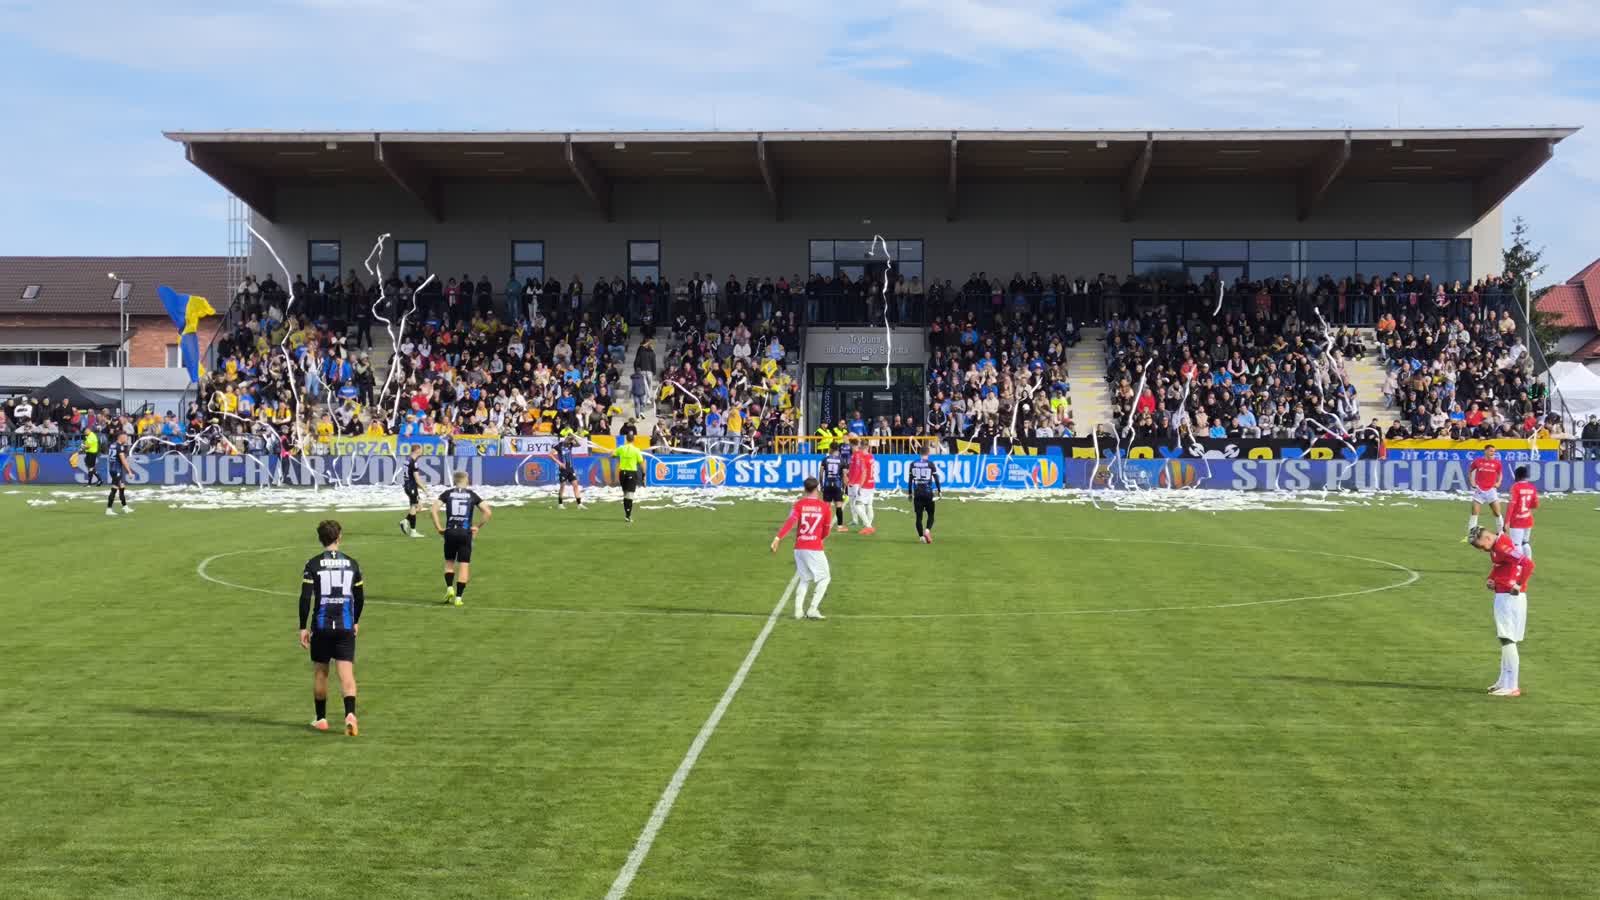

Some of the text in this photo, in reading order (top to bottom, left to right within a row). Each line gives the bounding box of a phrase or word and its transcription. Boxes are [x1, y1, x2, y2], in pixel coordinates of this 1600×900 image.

[333, 441, 447, 456] FORZA ORA
[164, 453, 328, 486] PUCHAR
[735, 460, 780, 483] STS
[912, 468, 932, 480] 99
[1232, 459, 1311, 489] STS
[1326, 460, 1473, 490] PUCHA
[800, 512, 822, 535] 57
[317, 570, 353, 595] 14
